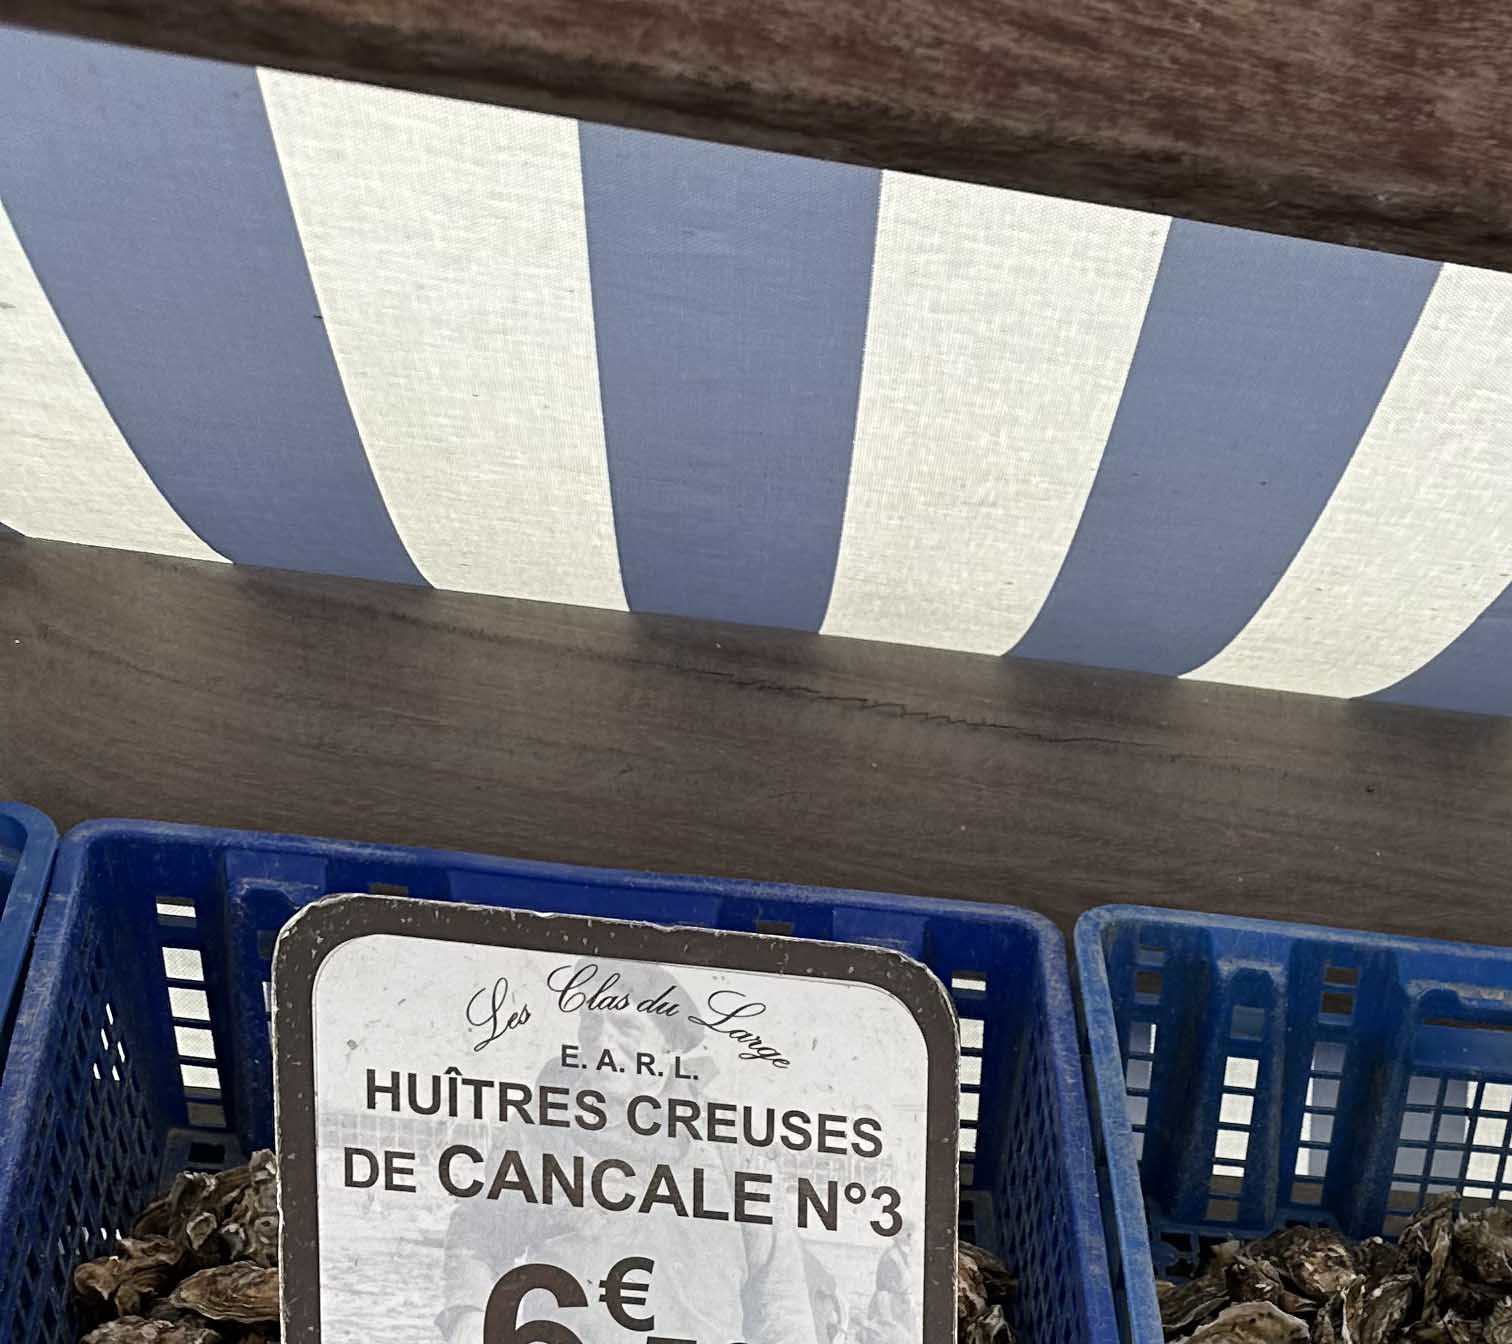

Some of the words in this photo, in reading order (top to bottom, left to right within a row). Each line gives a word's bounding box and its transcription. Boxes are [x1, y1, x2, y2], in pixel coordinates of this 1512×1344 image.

[467, 977, 531, 1052] Les
[547, 963, 630, 1017] Clas
[635, 985, 680, 1018] du
[689, 990, 790, 1070] Large
[367, 1066, 607, 1131] HUÎTRES
[627, 1095, 882, 1158] CREUSES
[344, 1147, 416, 1193] DE
[439, 1145, 773, 1225] CANCALE
[798, 1177, 902, 1237] N°3
